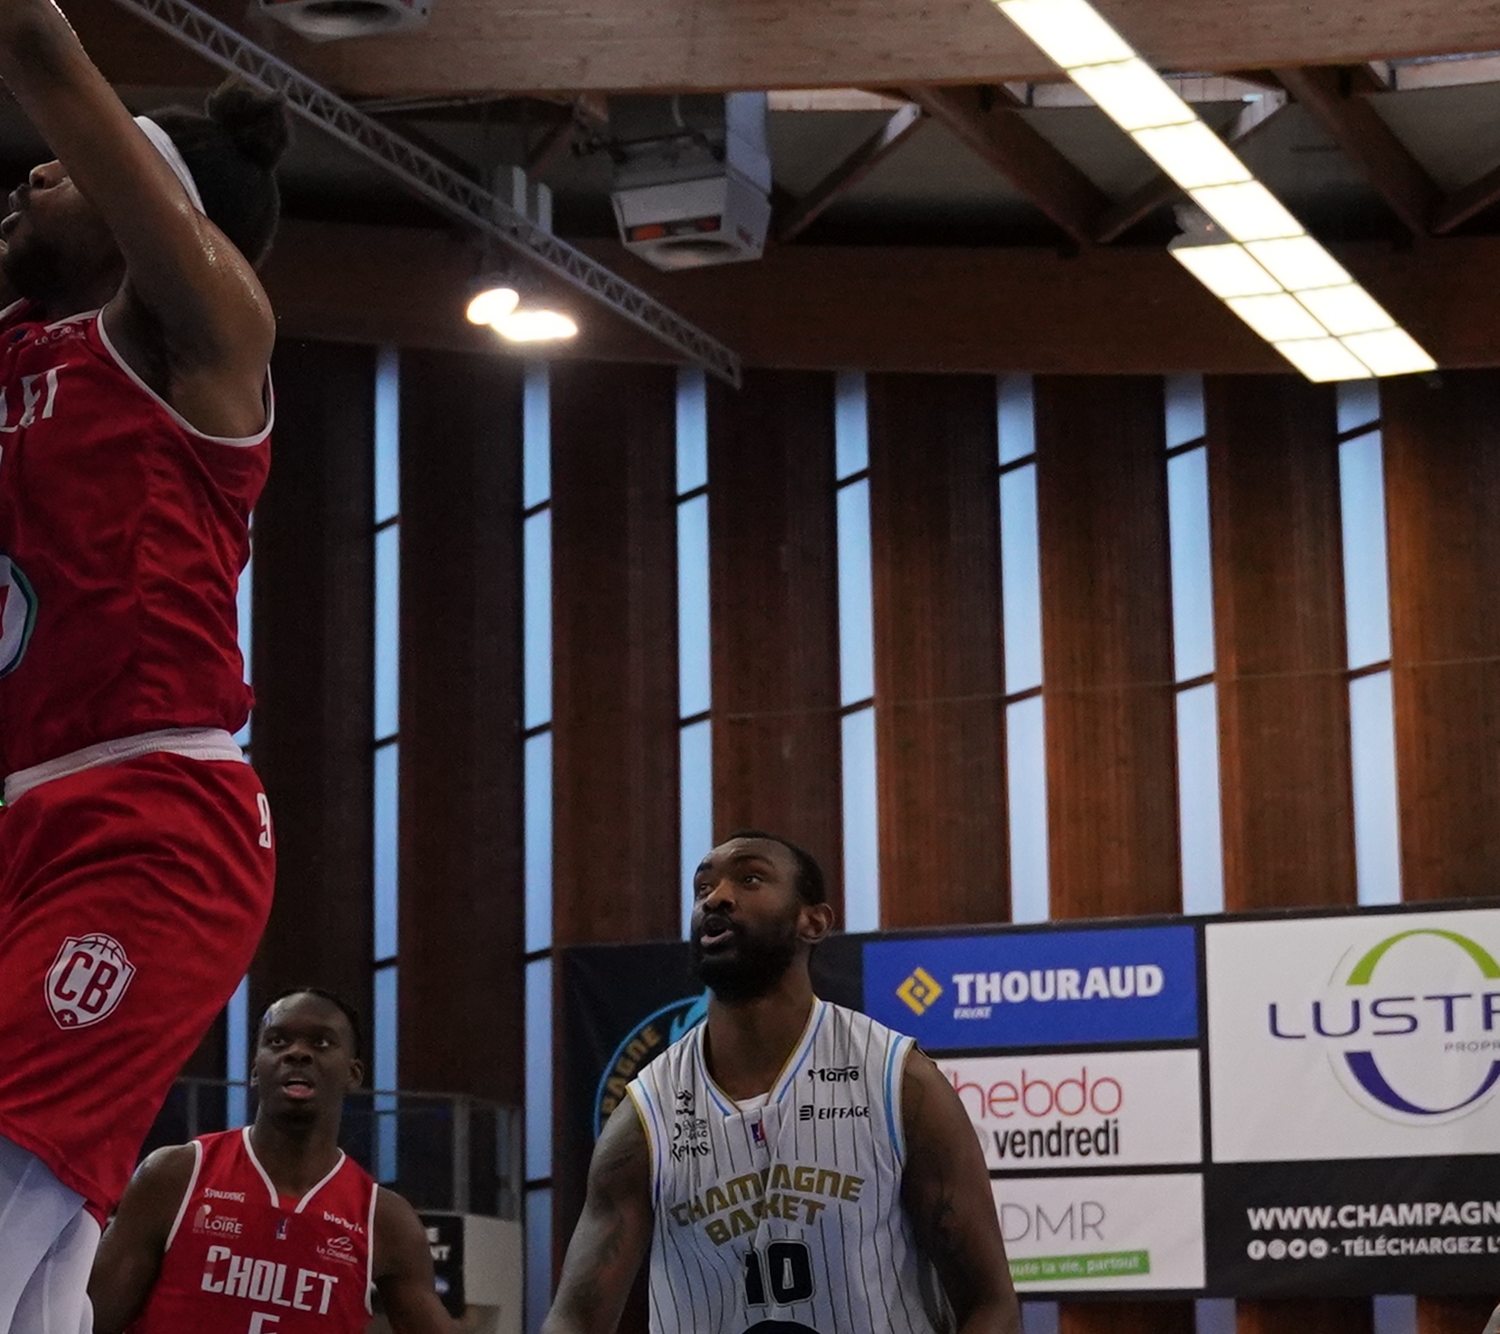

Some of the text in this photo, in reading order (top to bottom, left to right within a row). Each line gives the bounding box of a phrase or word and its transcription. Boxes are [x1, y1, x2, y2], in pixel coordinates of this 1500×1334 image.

[54, 951, 118, 1014] CB
[952, 965, 1164, 1005] THOURAUD
[818, 1105, 870, 1120] EIFFAGE
[993, 1119, 1119, 1159] vendredi
[670, 1164, 865, 1227] CHAMAGNE
[205, 1219, 243, 1234] LOIRE
[1001, 1201, 1106, 1242] DMR
[1342, 1234, 1483, 1257] TÉLÉCHARGEZ
[201, 1245, 339, 1315] CHOLET
[744, 1238, 816, 1307] 10
